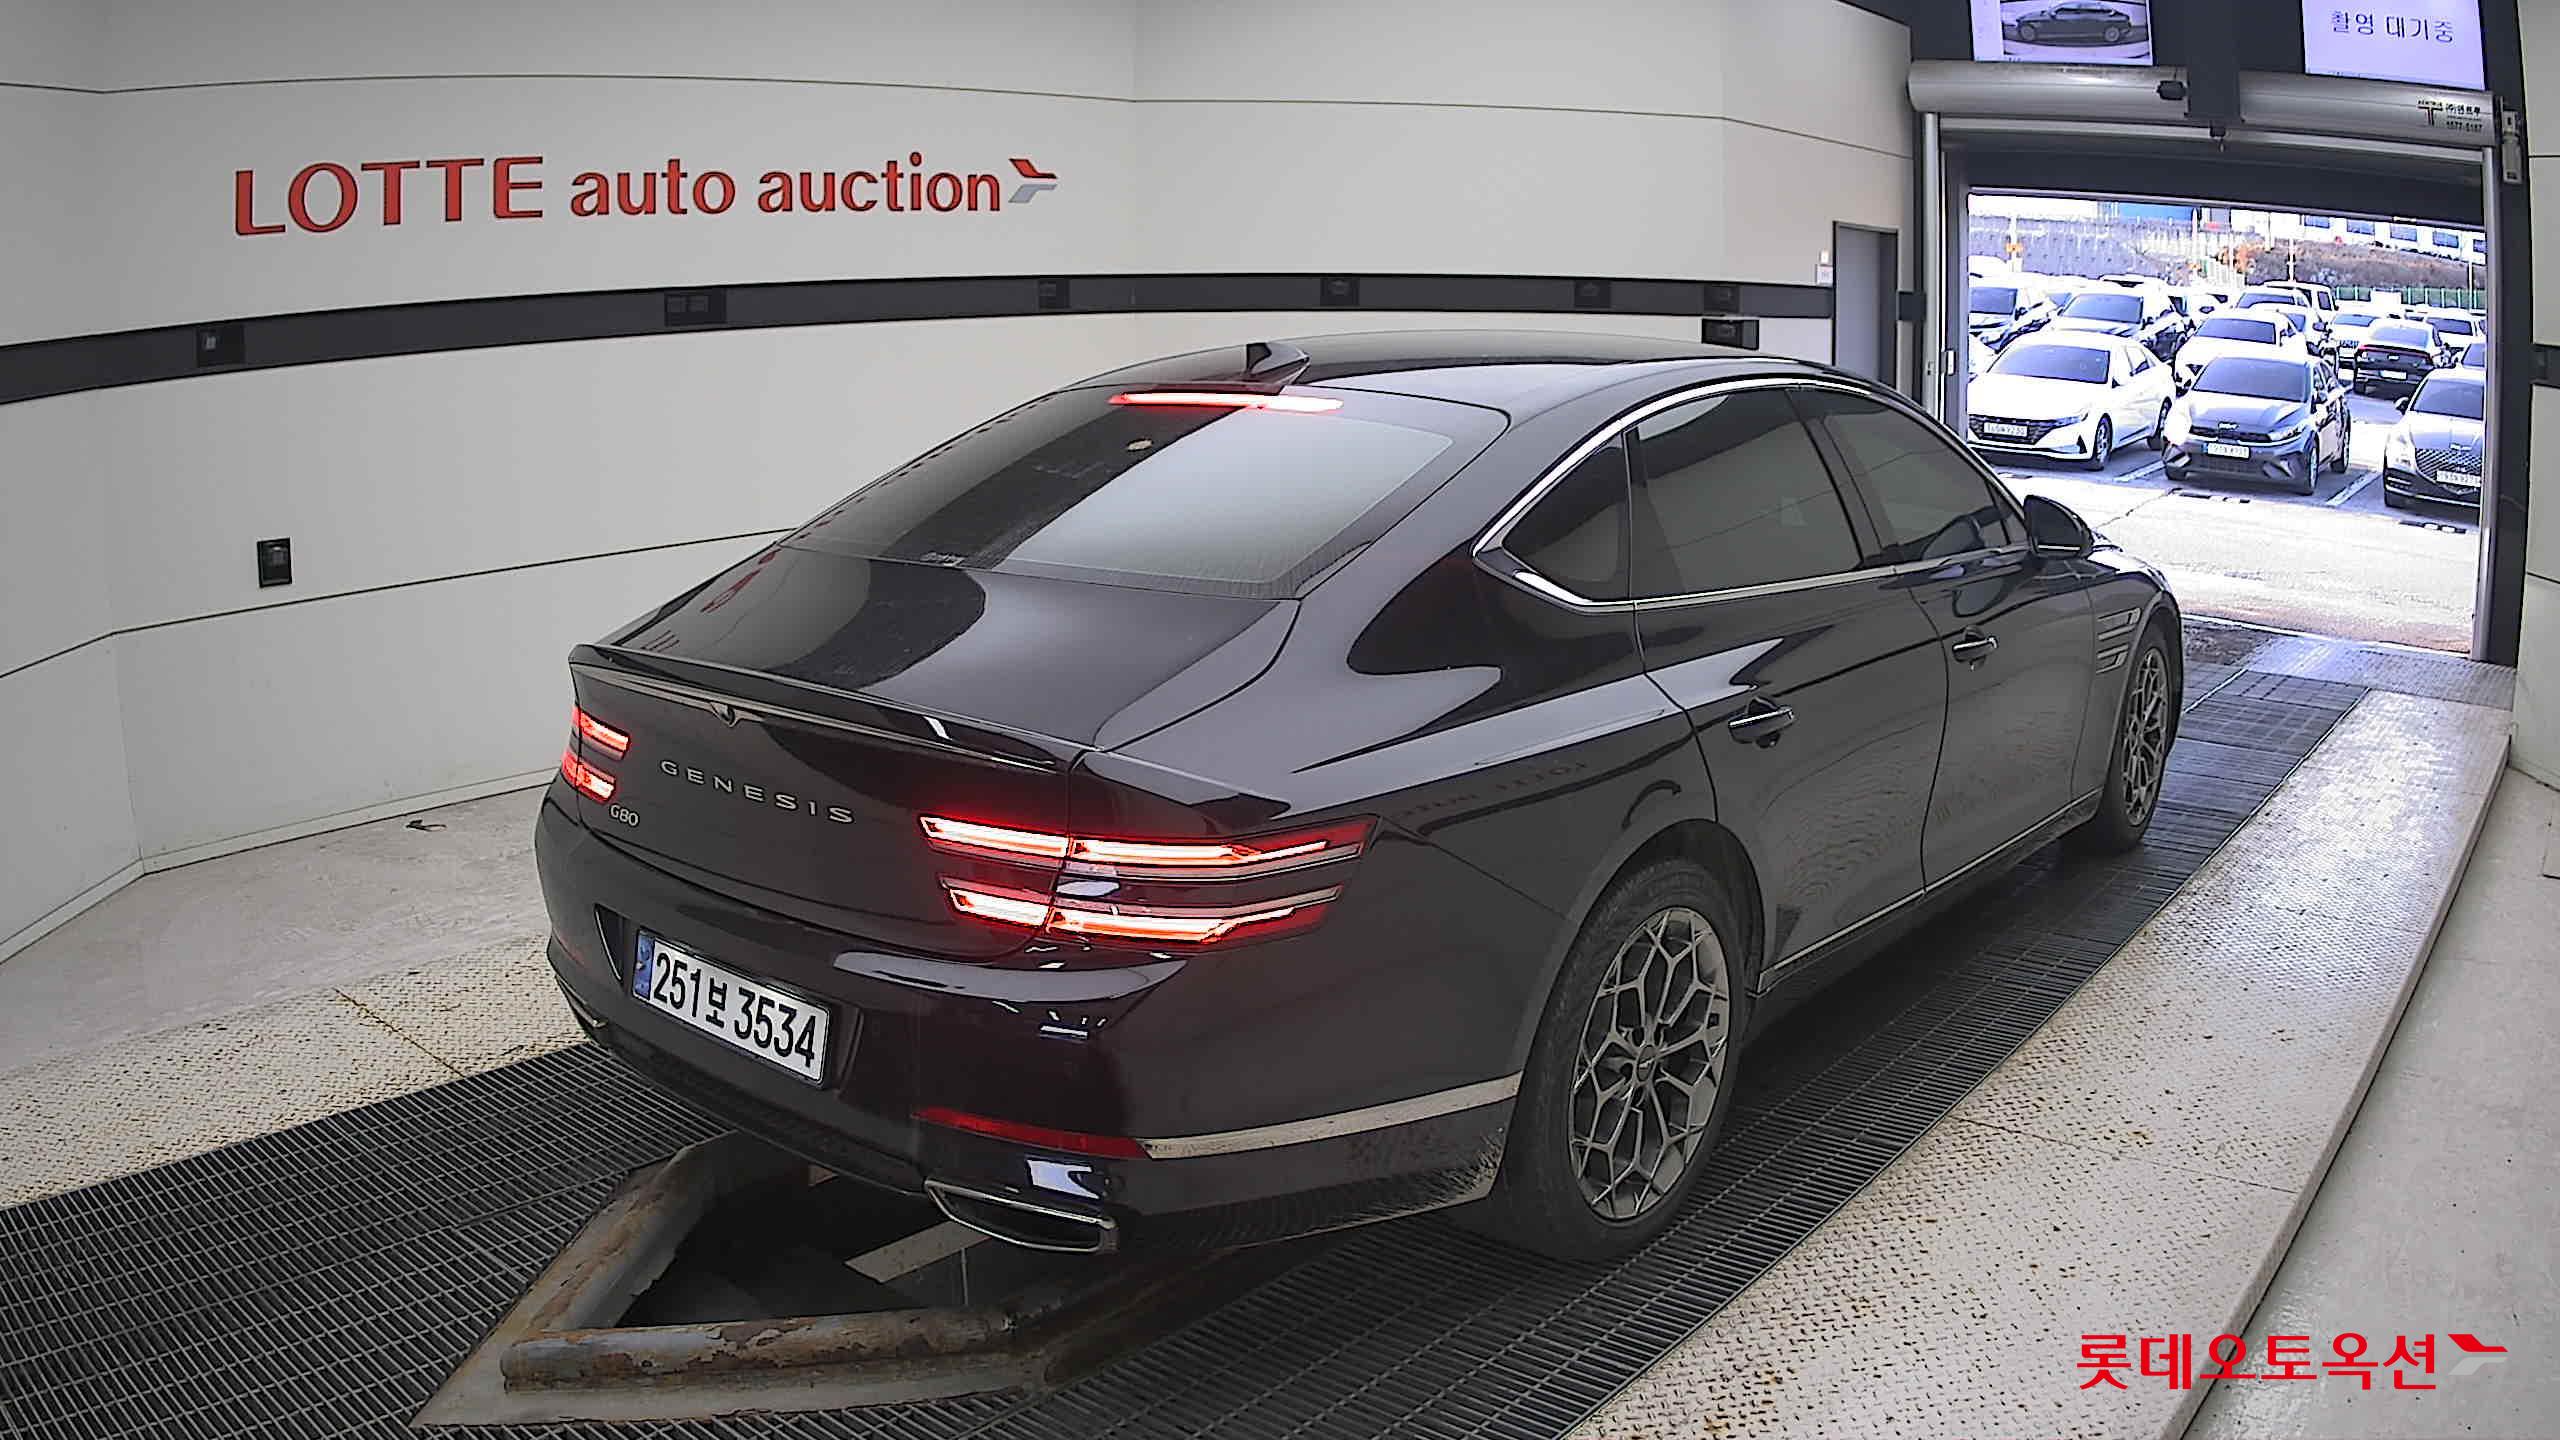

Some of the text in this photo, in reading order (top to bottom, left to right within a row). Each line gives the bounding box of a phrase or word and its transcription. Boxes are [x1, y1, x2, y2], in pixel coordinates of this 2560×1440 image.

[2331, 11, 2453, 43] 촬영 대기중
[235, 152, 1001, 236] LOTTE auto auction
[609, 803, 640, 827] G80
[660, 760, 853, 824] GENESIS
